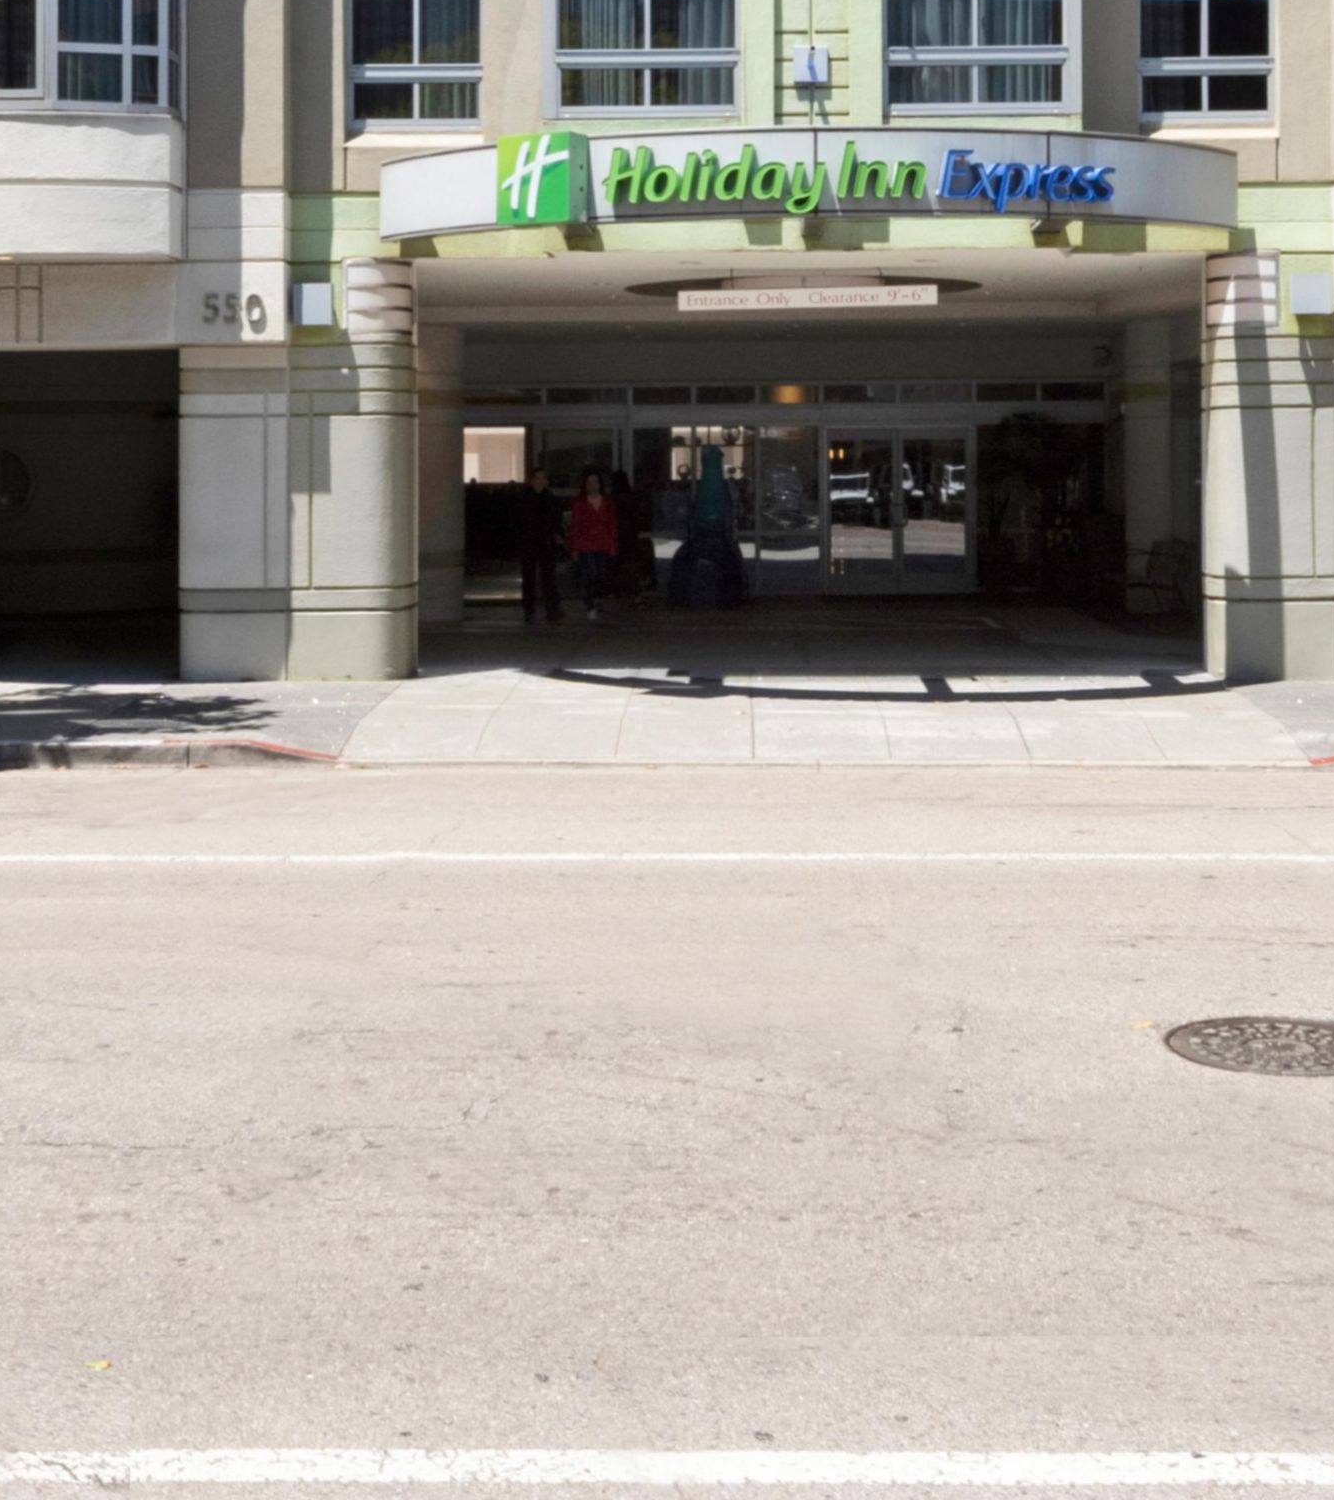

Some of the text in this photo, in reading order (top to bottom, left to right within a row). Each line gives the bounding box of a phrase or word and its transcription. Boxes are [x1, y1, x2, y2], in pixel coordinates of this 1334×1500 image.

[602, 140, 1116, 214] Holiday Inn Express
[202, 292, 264, 327] 550
[686, 294, 749, 307] Entrance
[756, 292, 792, 306] Only
[808, 290, 880, 304] Clearance
